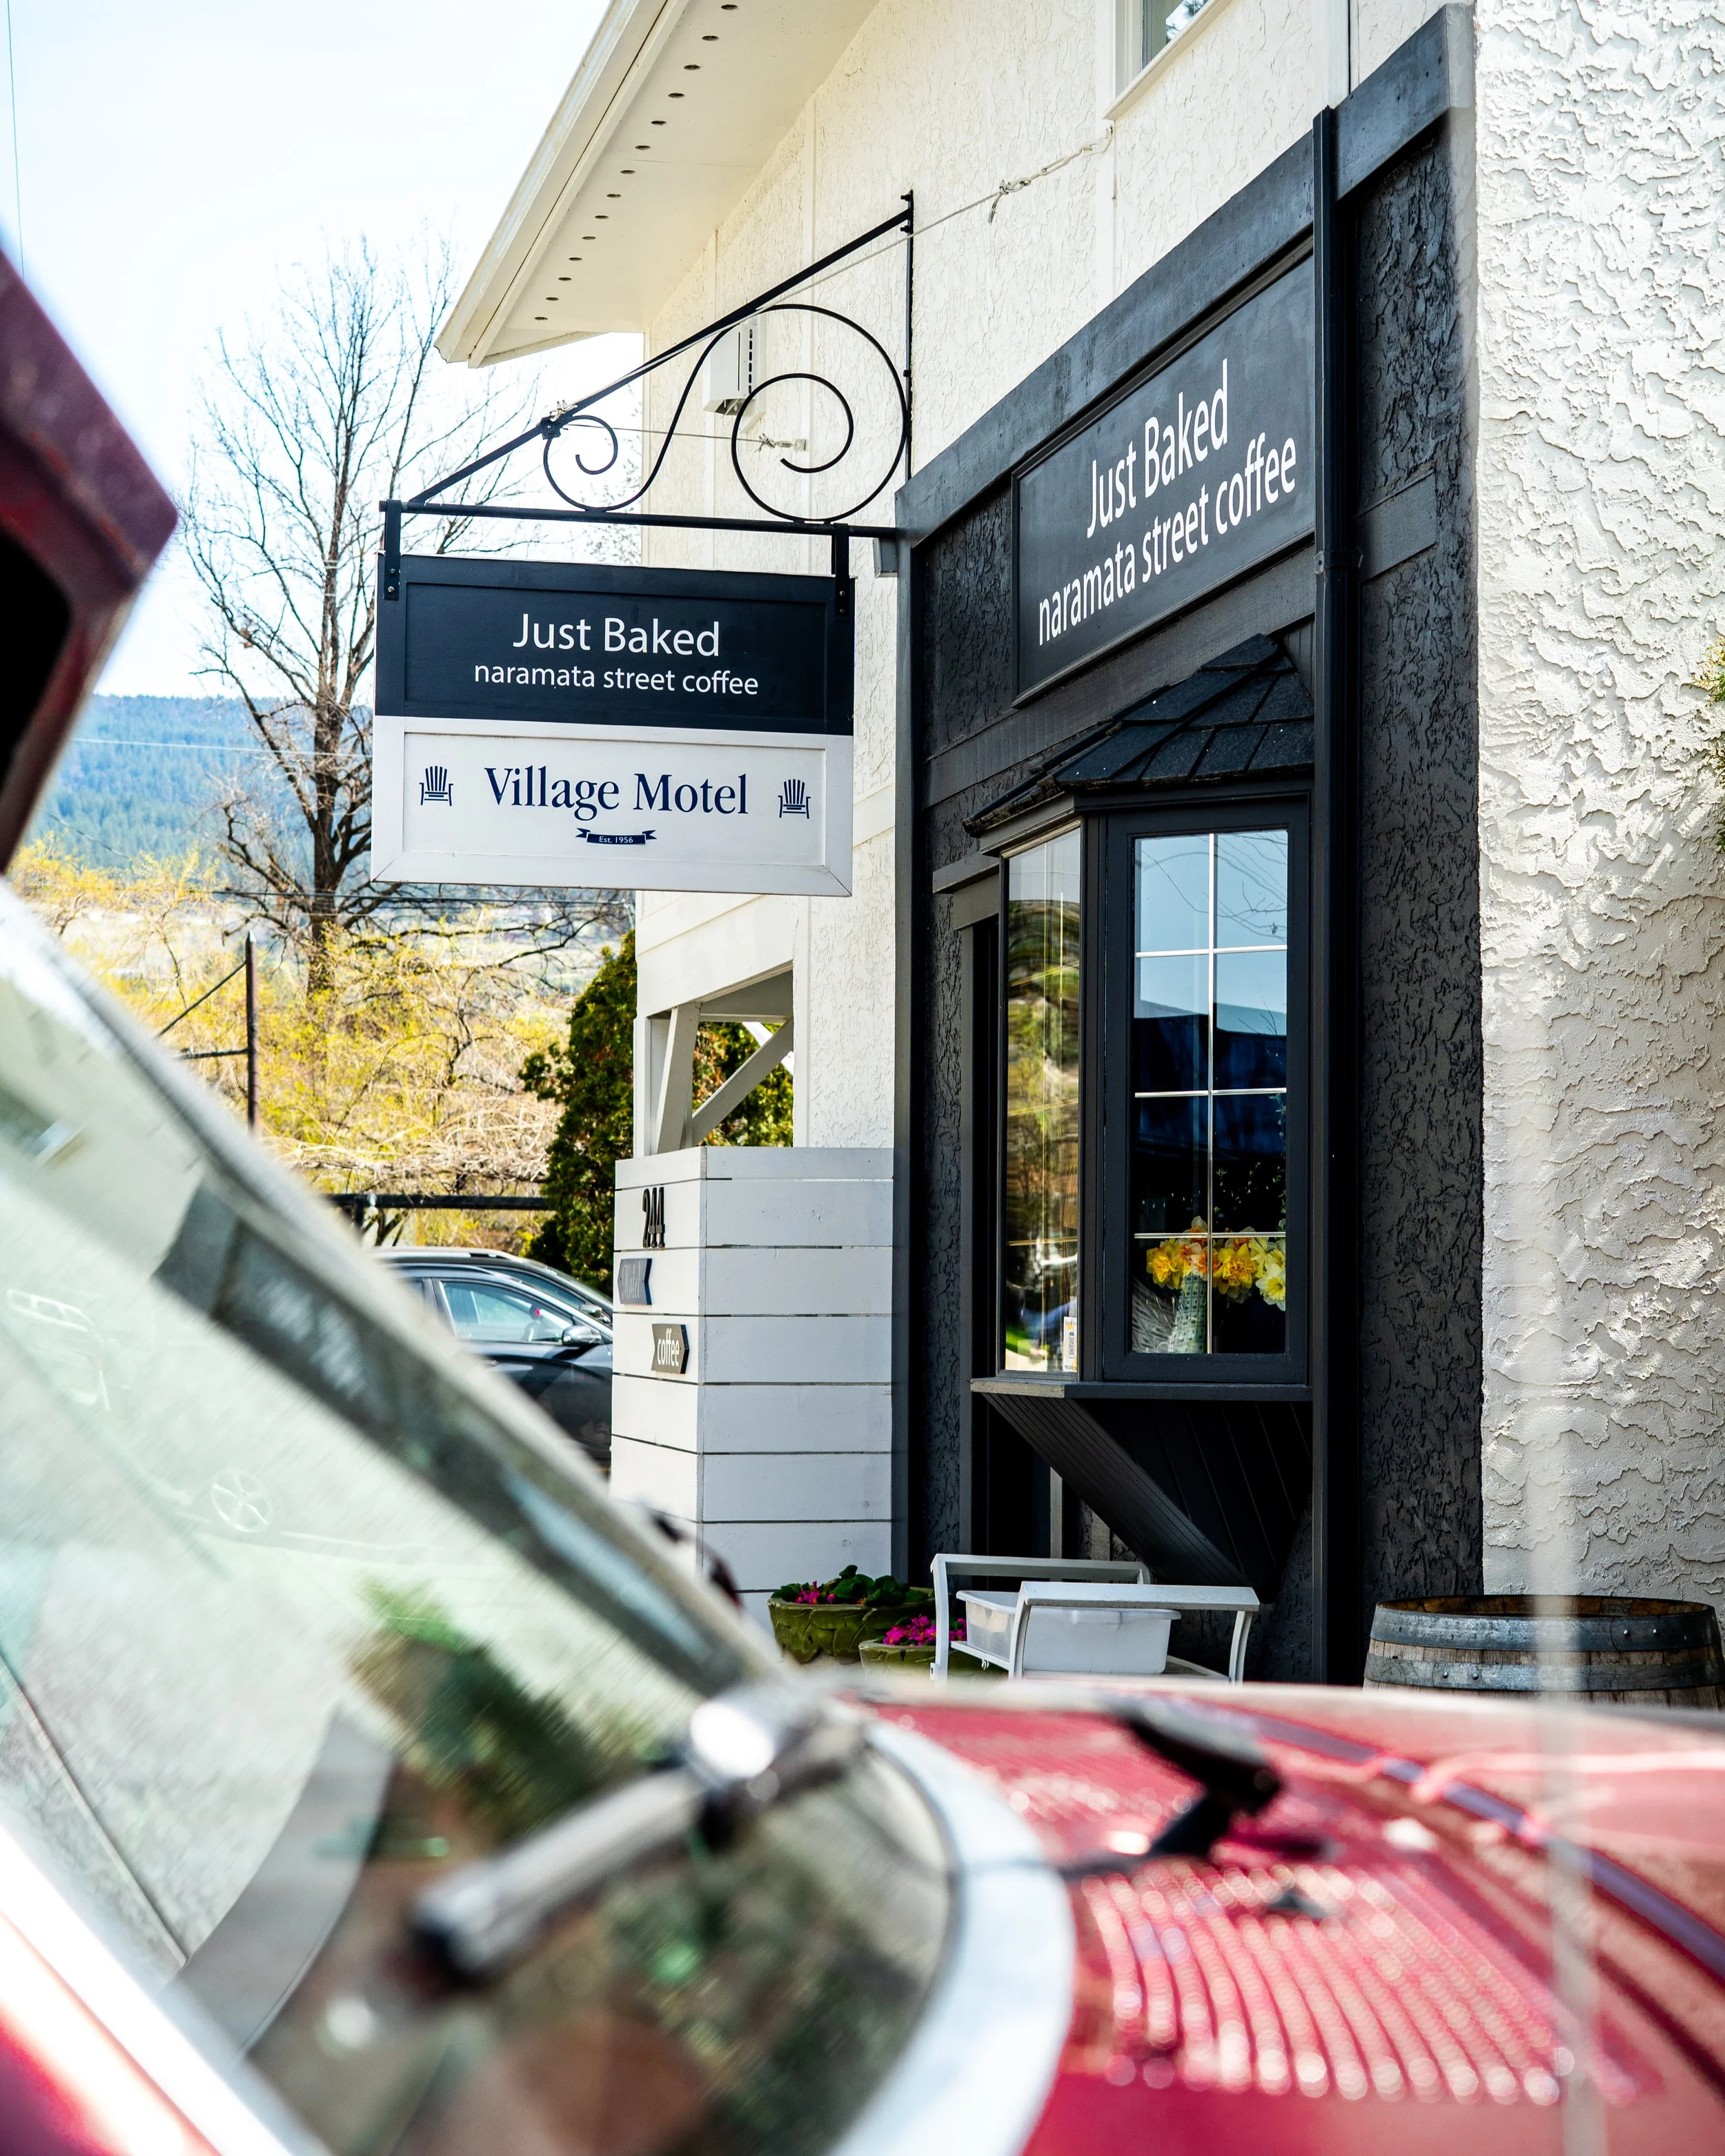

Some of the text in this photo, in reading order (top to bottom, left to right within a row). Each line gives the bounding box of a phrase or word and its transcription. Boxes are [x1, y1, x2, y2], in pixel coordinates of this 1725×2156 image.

[1087, 357, 1228, 539] Just Baked
[1039, 432, 1297, 646] naramata street coffee
[513, 613, 719, 657] Just Baked
[475, 665, 758, 695] naramata street coffee
[484, 765, 749, 821] Village Motel
[657, 1327, 680, 1367] coffee
